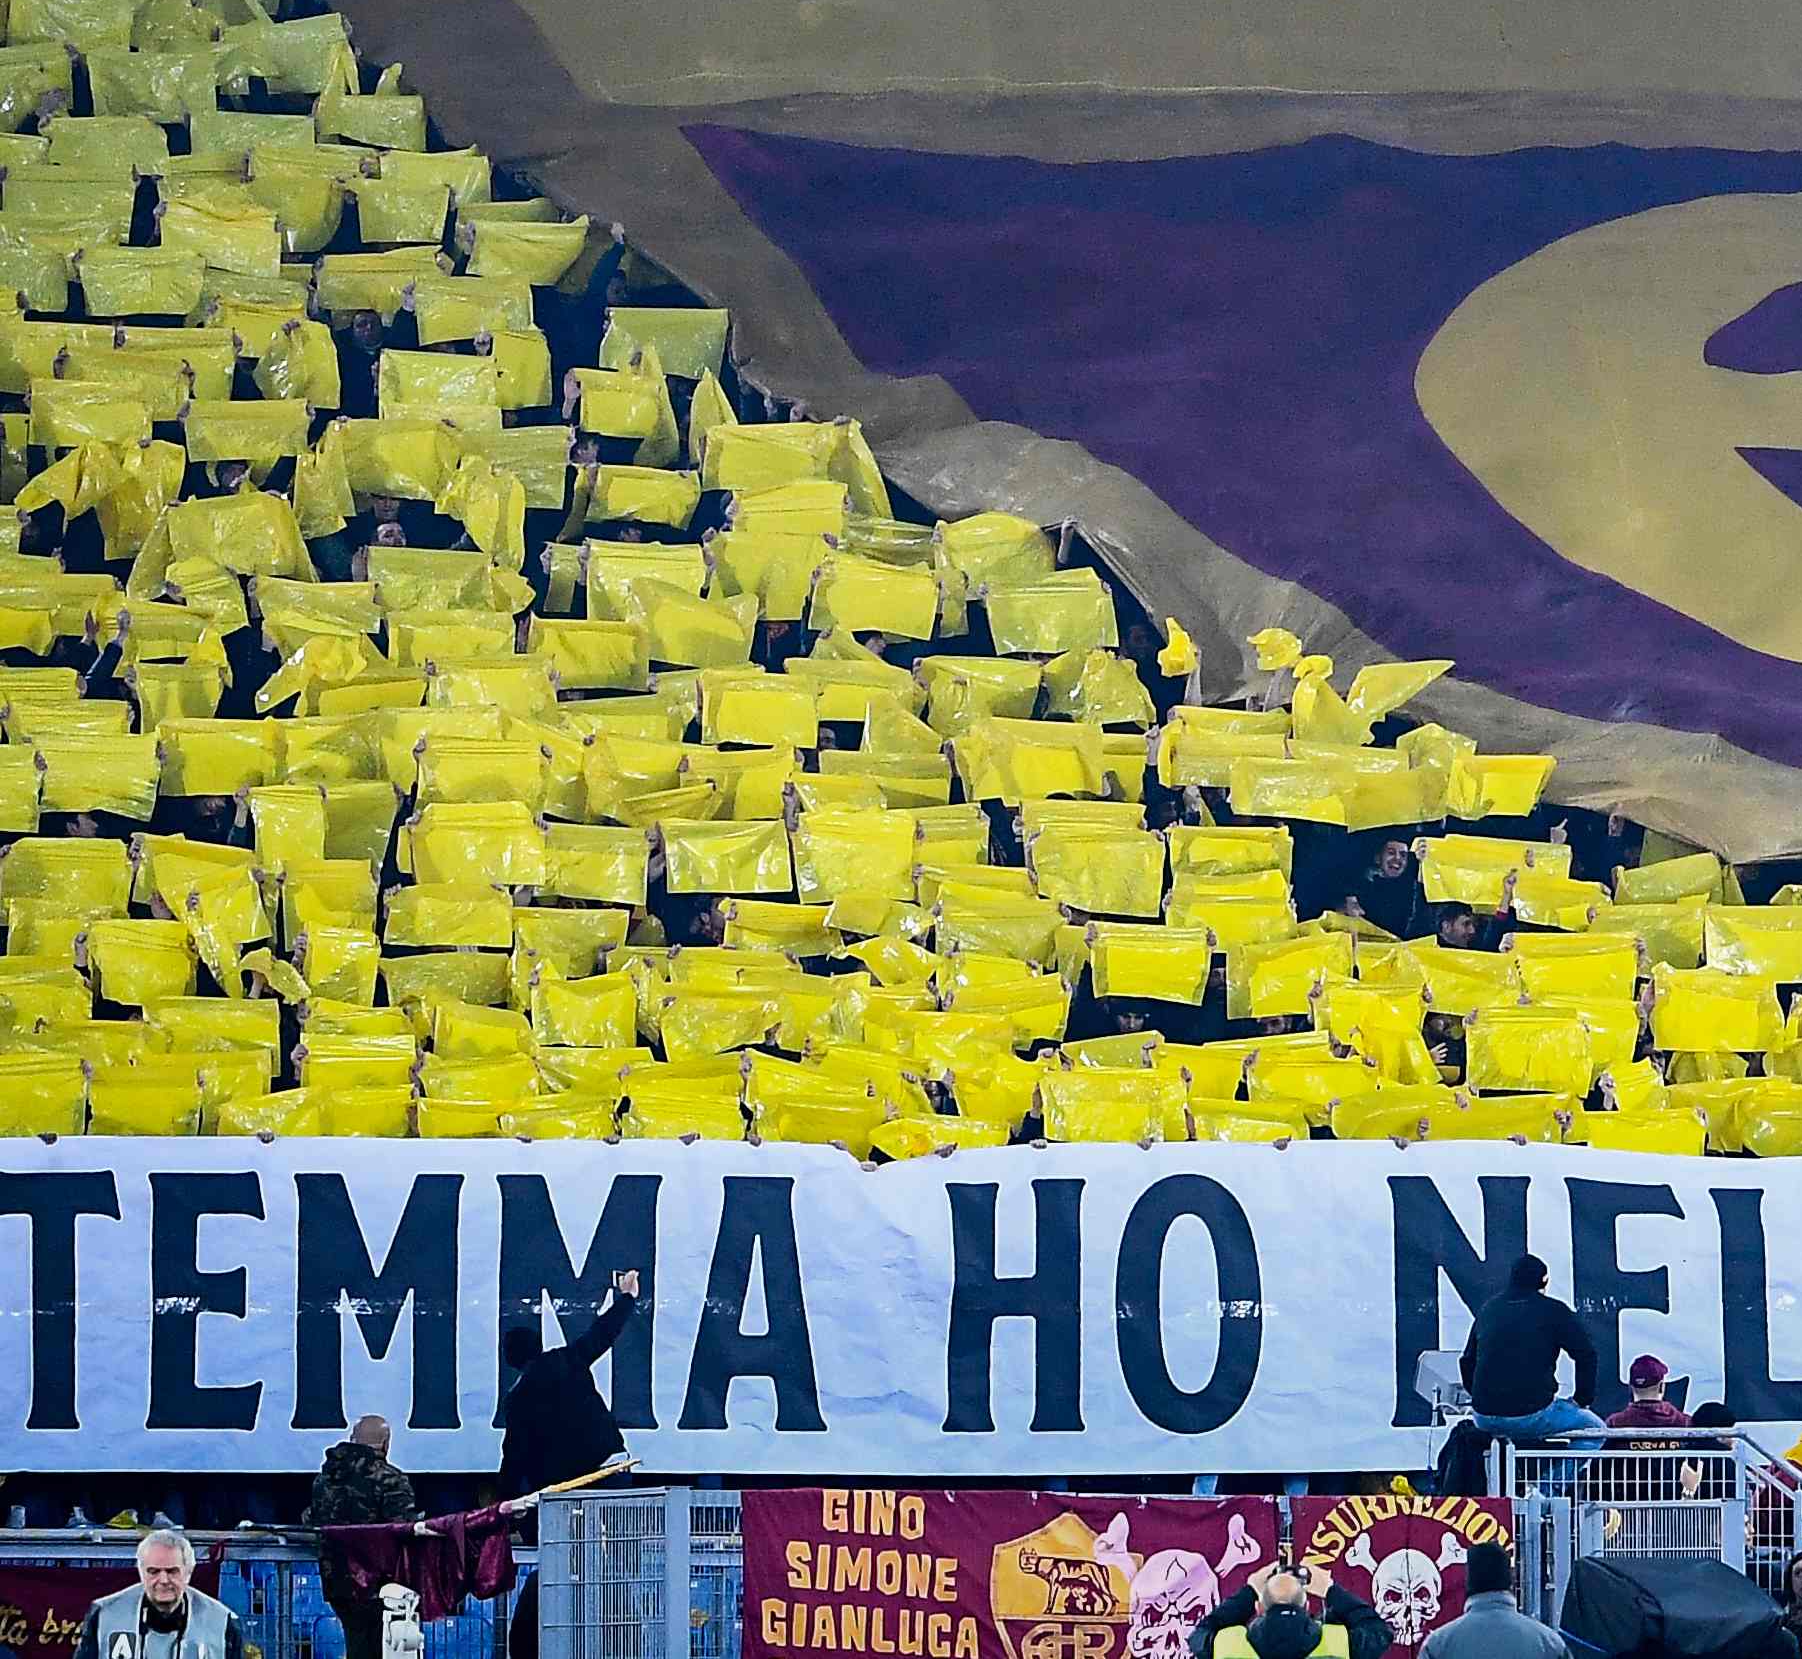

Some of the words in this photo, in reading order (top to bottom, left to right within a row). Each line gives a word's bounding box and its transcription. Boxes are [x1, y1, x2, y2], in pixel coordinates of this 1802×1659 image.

[0, 1171, 829, 1432] TEMMA
[941, 1173, 1266, 1435] HO
[823, 1489, 926, 1540] GINO
[786, 1541, 958, 1601] SIMONE
[761, 1598, 979, 1659] GIANLUCA
